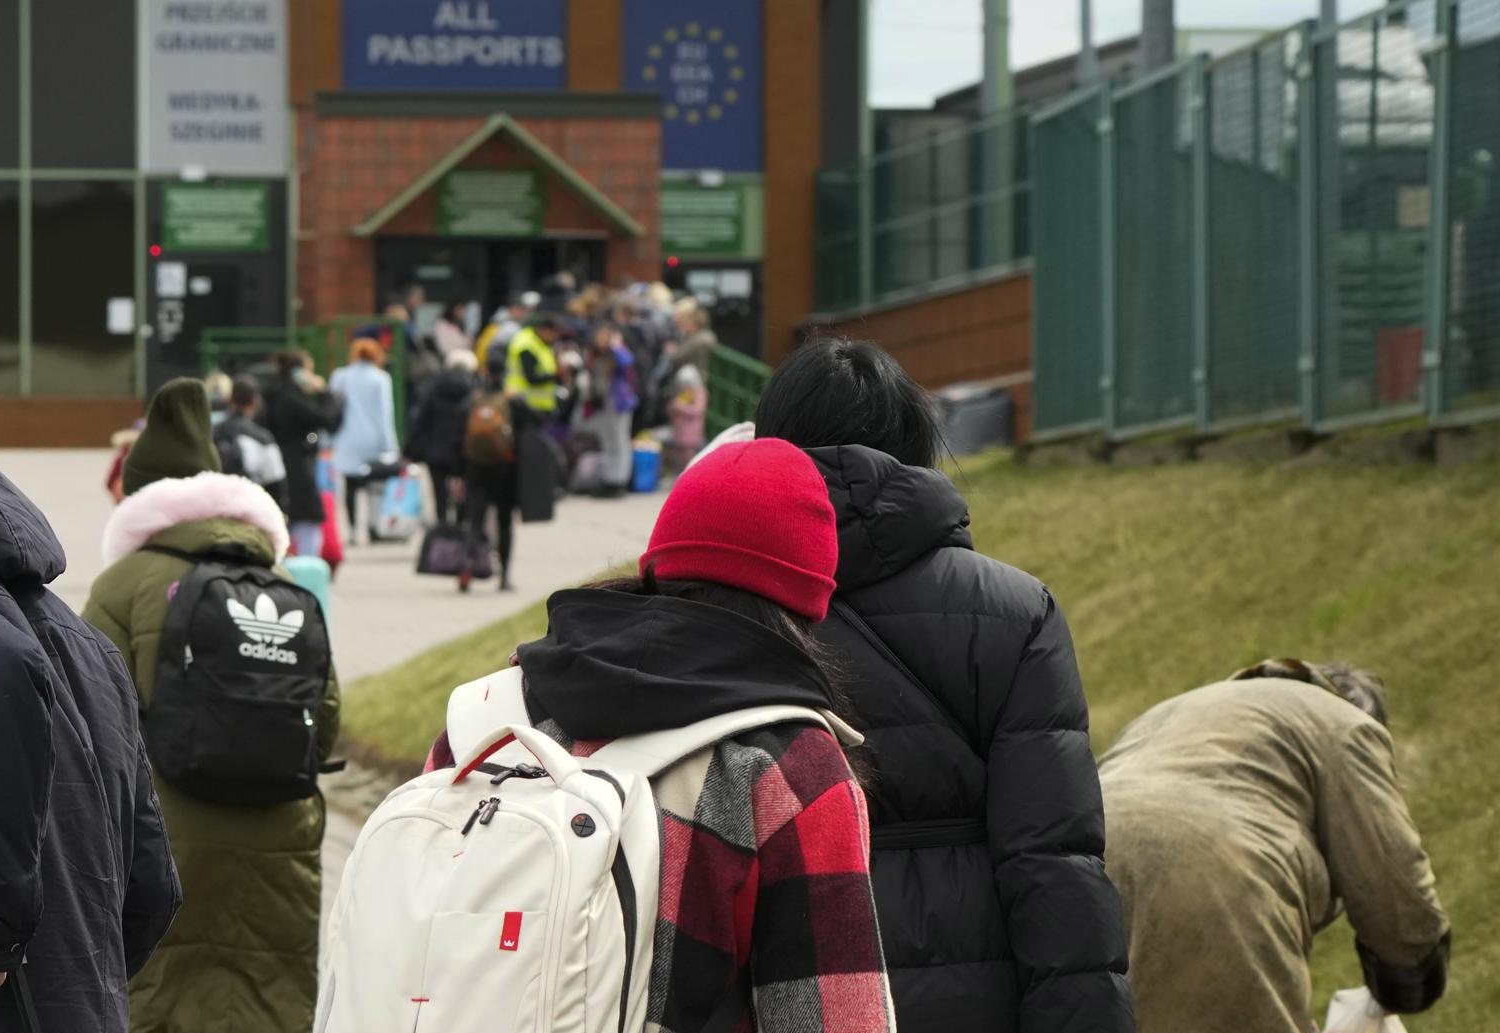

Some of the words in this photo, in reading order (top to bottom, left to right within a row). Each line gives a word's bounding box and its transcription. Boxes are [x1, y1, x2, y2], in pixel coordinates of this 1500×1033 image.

[433, 0, 499, 30] ALL
[366, 34, 564, 66] PASSPORTS
[239, 642, 298, 665] adidas
